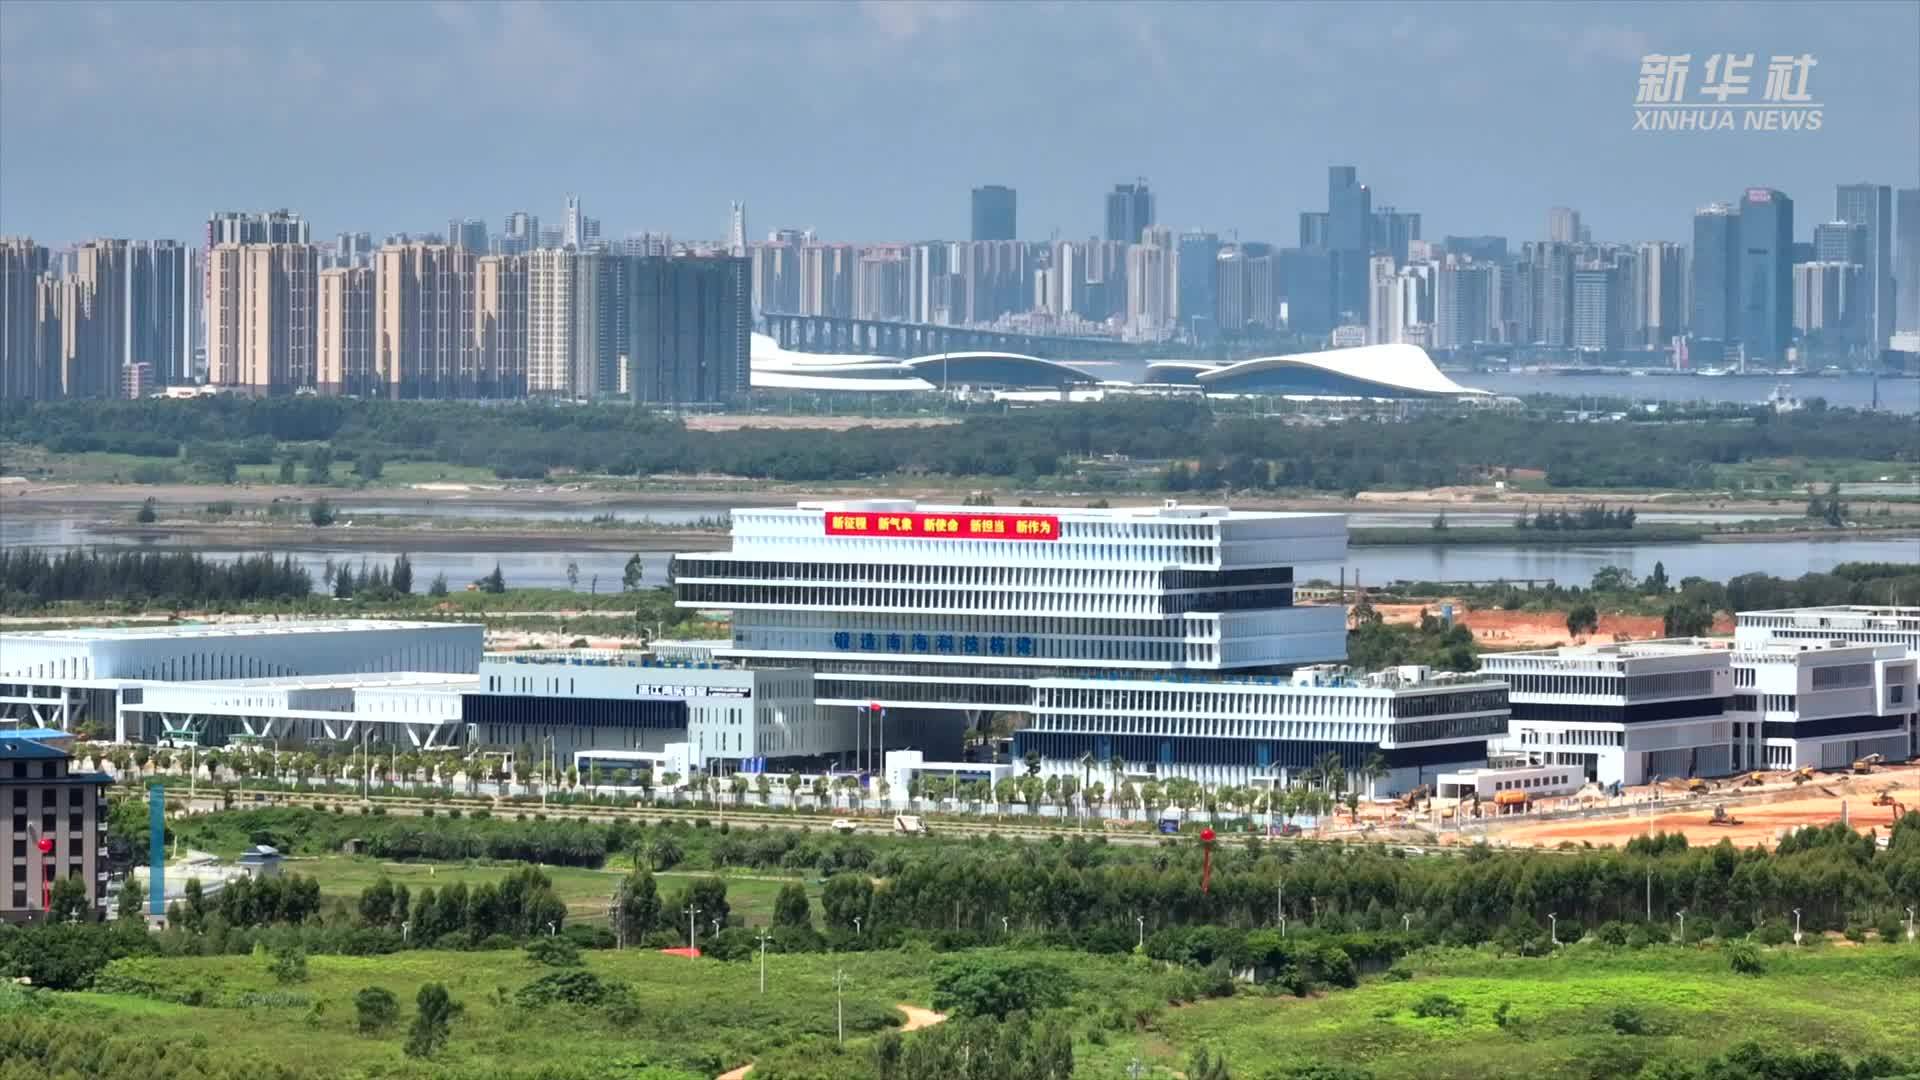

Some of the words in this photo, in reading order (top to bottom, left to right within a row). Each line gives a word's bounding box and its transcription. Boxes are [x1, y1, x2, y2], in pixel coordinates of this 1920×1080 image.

[832, 516, 867, 531] 新征程
[878, 517, 912, 532] 新气象
[923, 518, 959, 533] 新使命
[969, 518, 1005, 534] 新担当
[1015, 519, 1051, 535] 新作为
